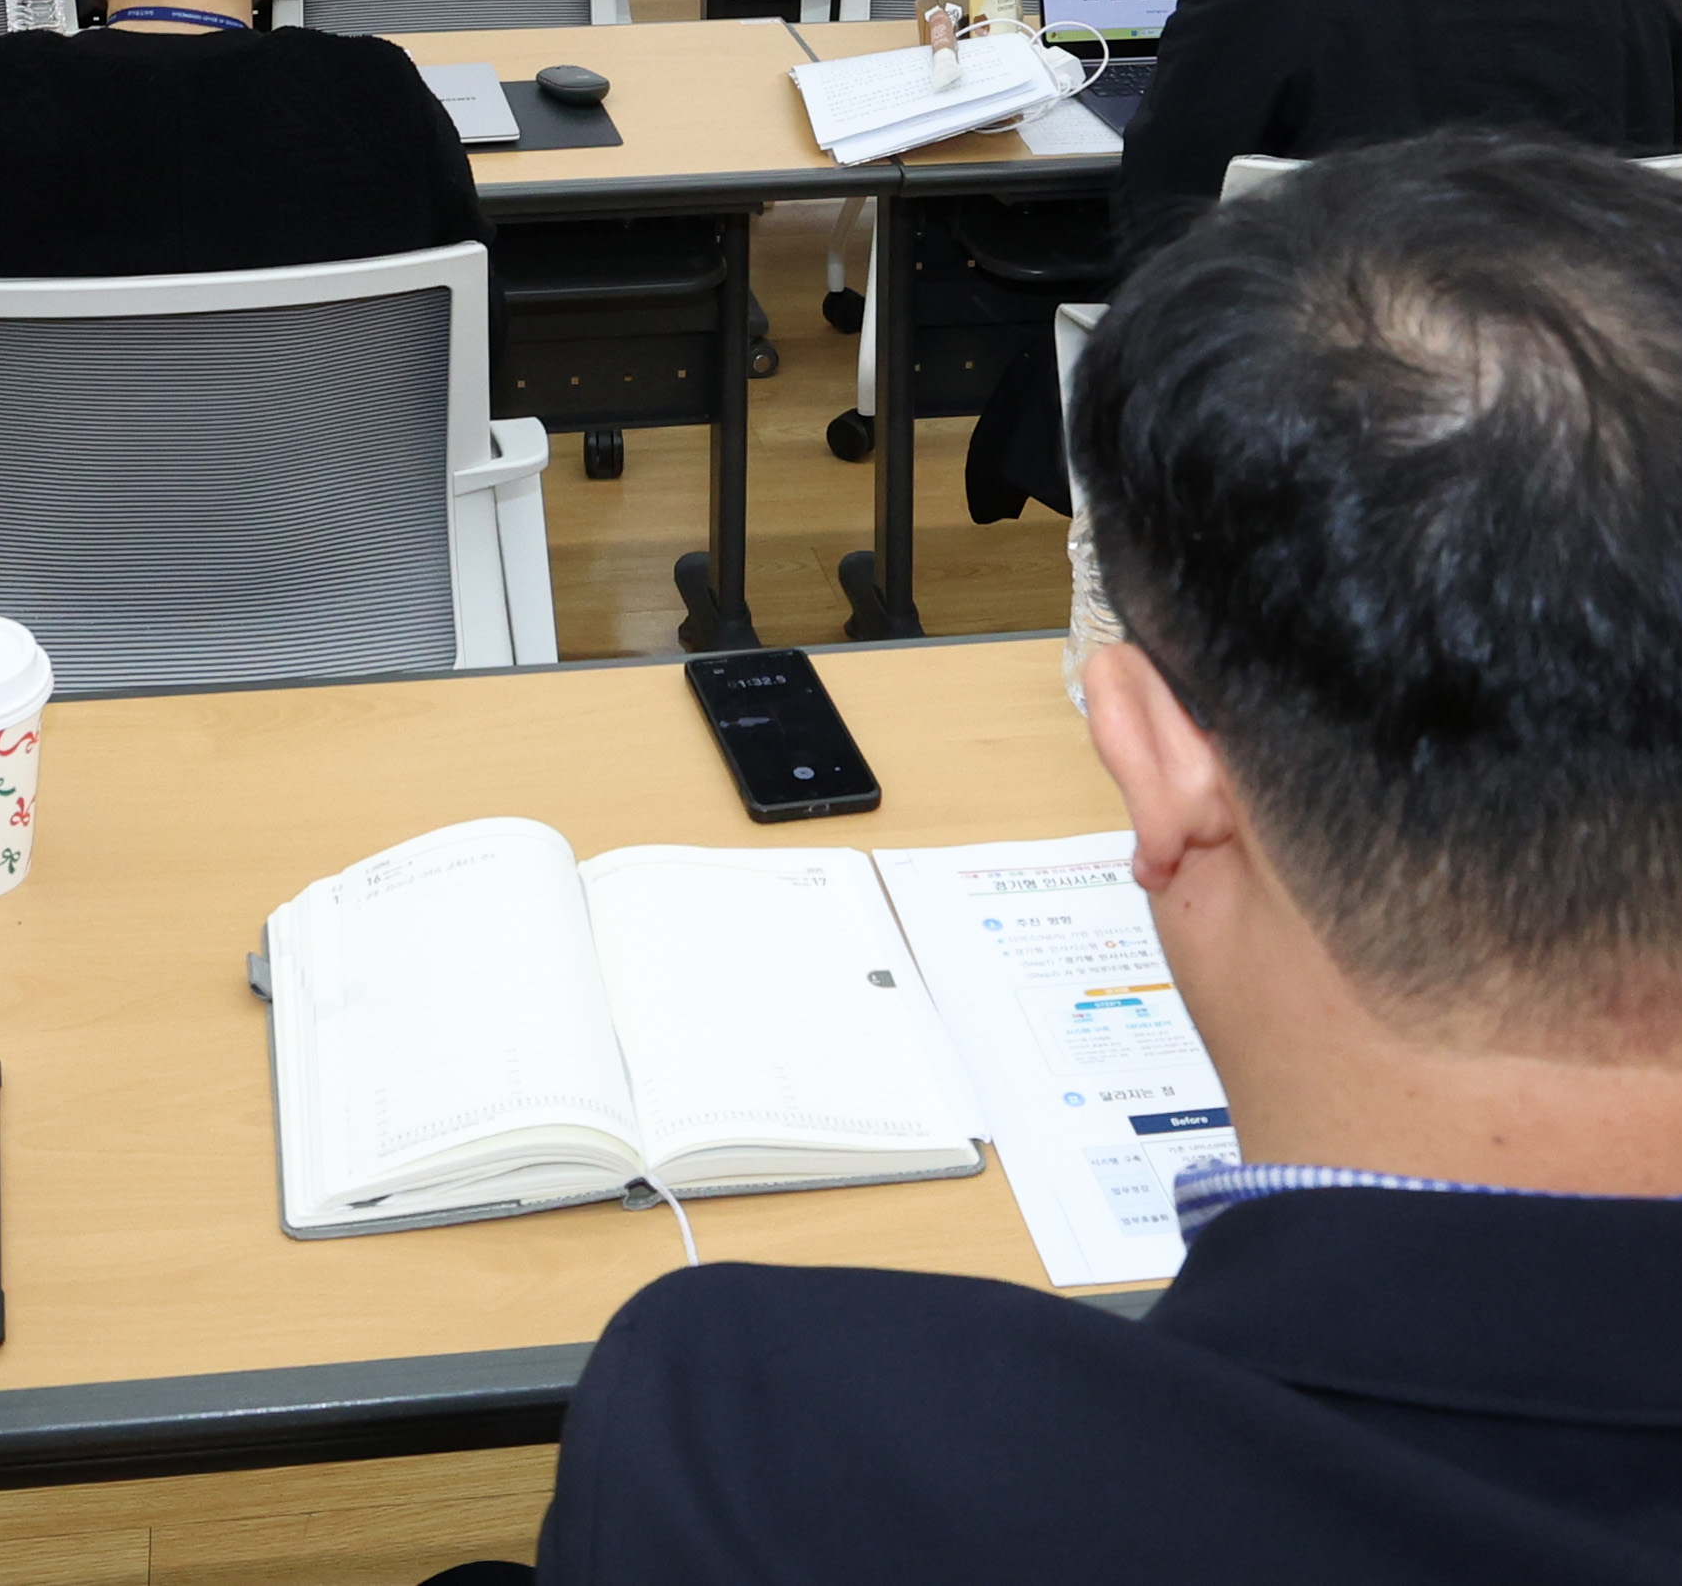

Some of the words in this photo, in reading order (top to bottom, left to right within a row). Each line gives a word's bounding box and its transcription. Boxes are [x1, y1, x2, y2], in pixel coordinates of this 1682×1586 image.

[367, 874, 381, 887] 16
[812, 877, 827, 887] 17
[992, 879, 1038, 892] 경기형
[1042, 871, 1118, 888] 인사시스템
[1016, 918, 1041, 928] 추진
[1049, 943, 1099, 955] 인사시스템
[1099, 1088, 1156, 1102] 달라지는
[1161, 1085, 1176, 1097] 점
[1170, 1116, 1209, 1127] Before
